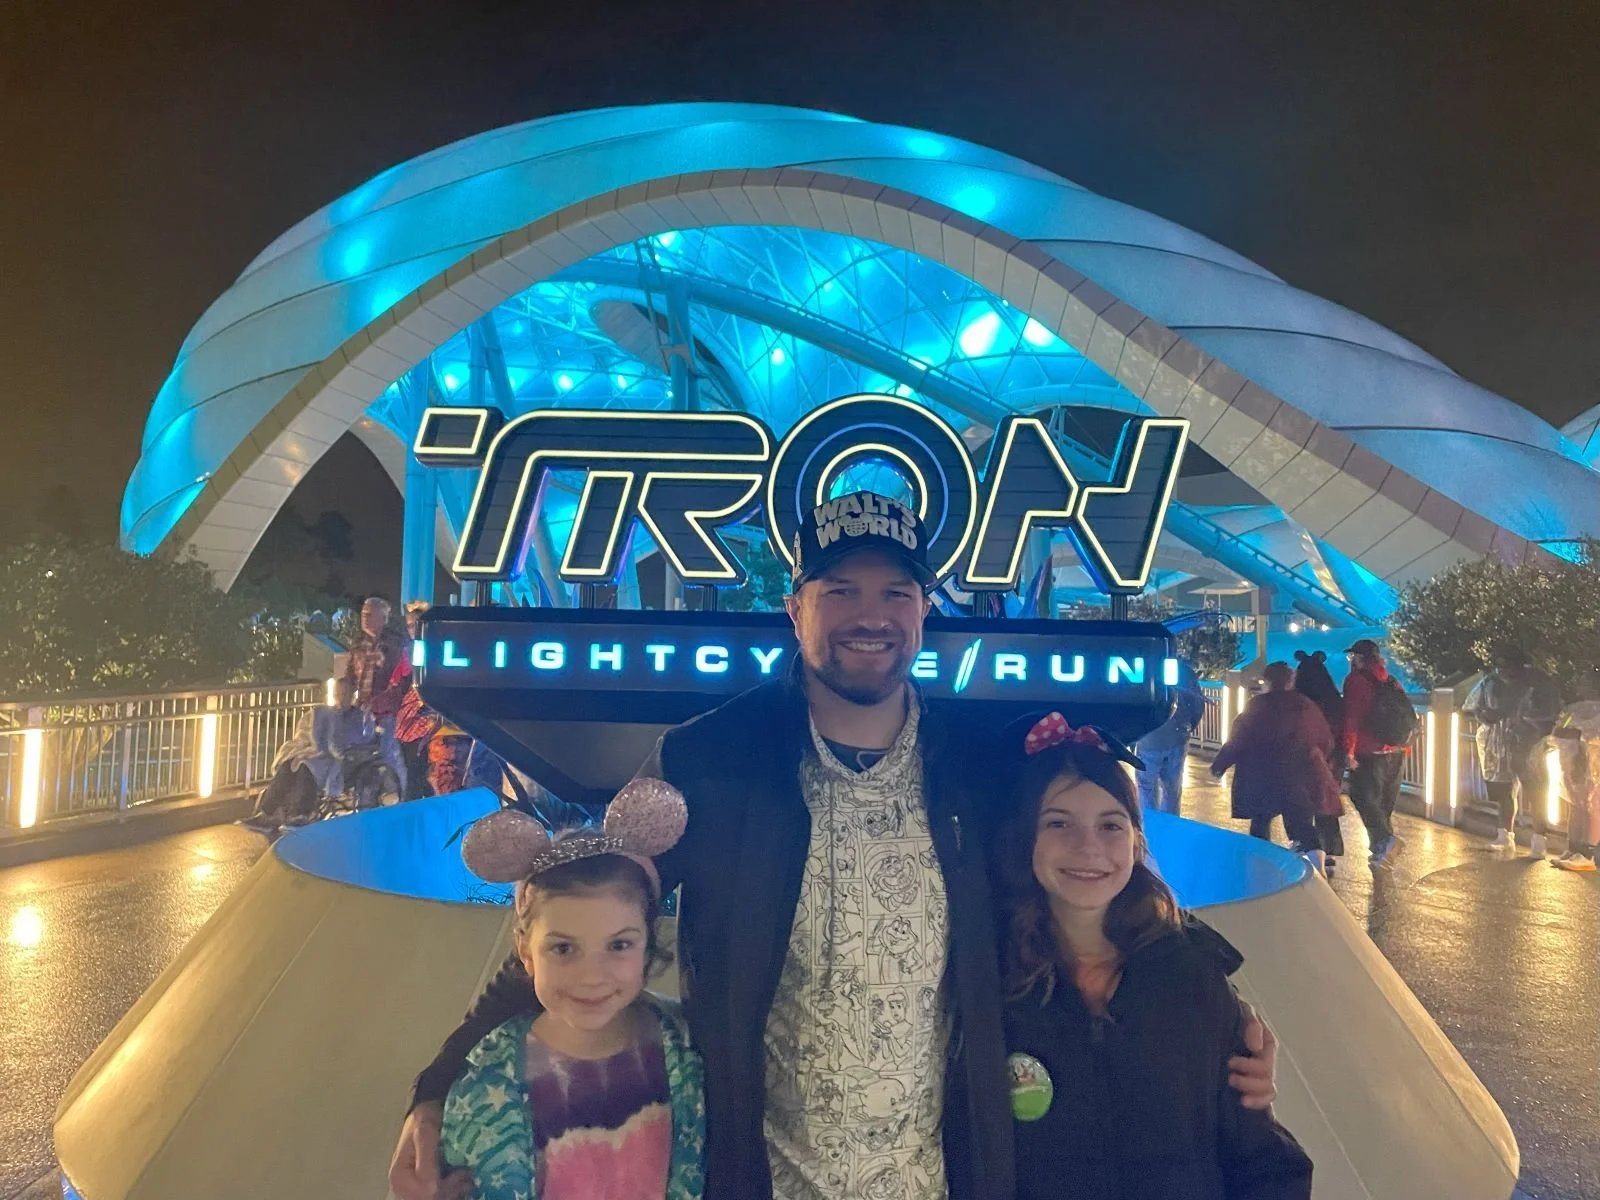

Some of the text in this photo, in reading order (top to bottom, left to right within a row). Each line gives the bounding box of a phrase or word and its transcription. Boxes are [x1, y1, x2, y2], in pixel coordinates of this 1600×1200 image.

[413, 393, 1192, 594] TRON
[813, 492, 918, 529] WALT'S
[816, 512, 919, 551] WORLD
[442, 640, 938, 678] LIGHTCYE
